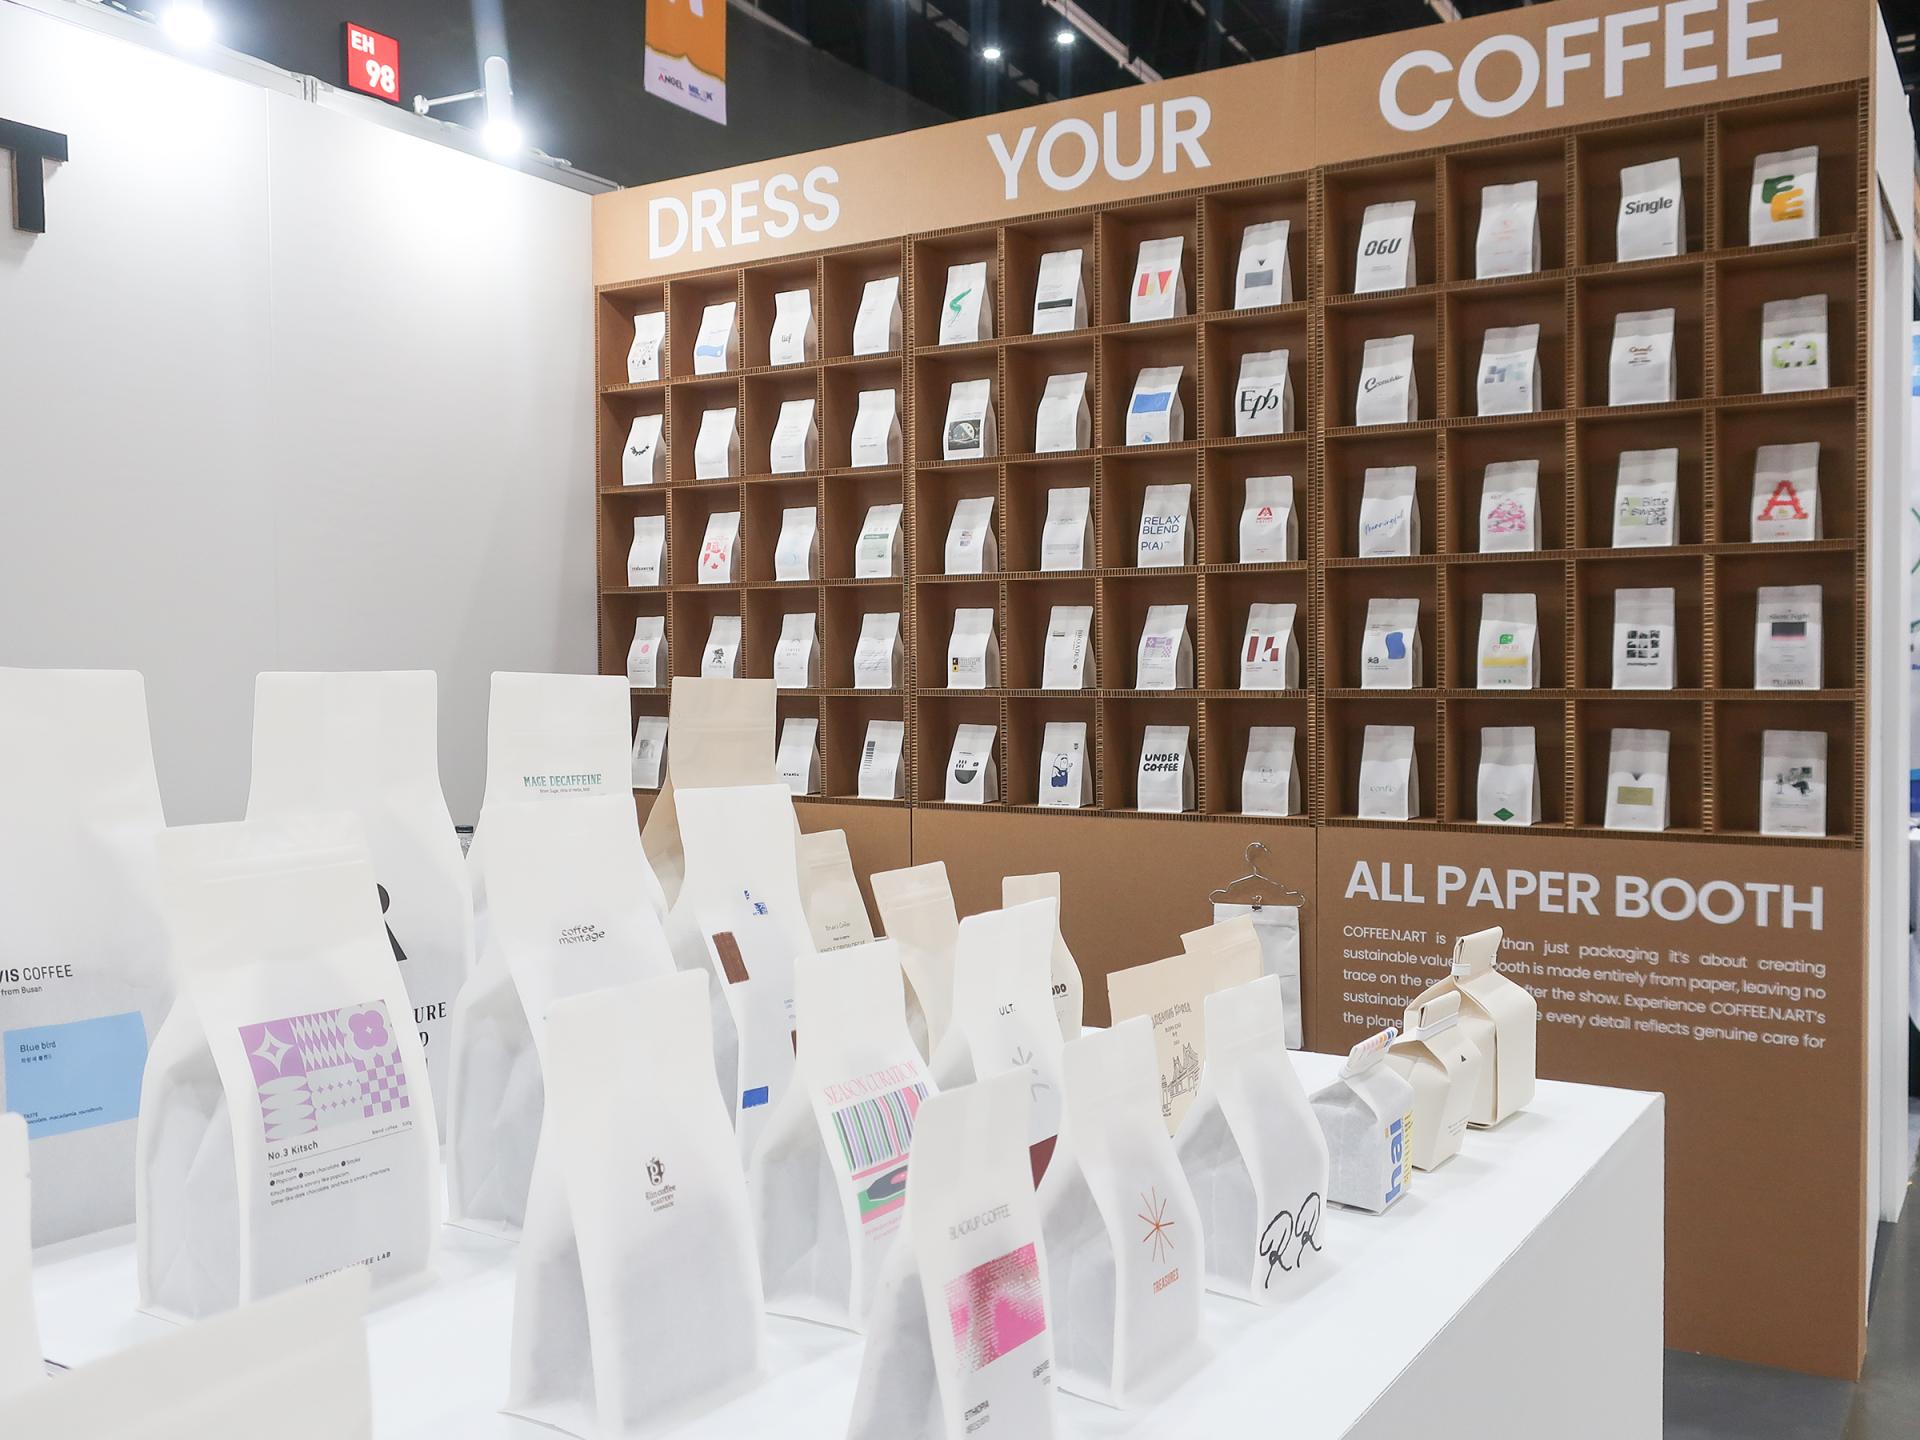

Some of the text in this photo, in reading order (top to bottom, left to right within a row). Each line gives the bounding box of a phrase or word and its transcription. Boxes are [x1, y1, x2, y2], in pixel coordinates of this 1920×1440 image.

[351, 29, 375, 56] EH
[1378, 0, 1783, 132] COFFEE
[366, 59, 396, 93] 98
[658, 73, 683, 90] ANGEL
[986, 96, 1211, 200] YOUR
[648, 165, 841, 260] DRESS
[1625, 197, 1673, 215] Single
[1364, 238, 1402, 256] OGU
[1144, 515, 1180, 525] RELAX
[1143, 525, 1179, 534] BLEND
[1145, 753, 1179, 762] UNDER
[549, 773, 602, 786] DECAFFEINE
[1344, 861, 1824, 931] ALL PAPER BOOTH
[559, 931, 605, 944] montage
[562, 924, 595, 937] coffee
[1343, 926, 1826, 978] COFFEE.N.ART is than just packaging it's about creating
[23, 964, 73, 981] COFFEE
[1343, 948, 1418, 964] sustainable
[1533, 963, 1544, 975] is
[1546, 966, 1592, 980] made
[1593, 968, 1647, 987] entirely
[1649, 972, 1687, 988] from
[1689, 977, 1740, 995] paper,
[1742, 980, 1801, 1001] leaving
[1804, 987, 1826, 999] no
[22, 985, 43, 995] Busan
[1343, 969, 1377, 982] trace
[1380, 973, 1396, 984] on
[1400, 973, 1422, 987] the
[1552, 987, 1576, 1001] the
[1579, 990, 1621, 1005] show.
[1624, 994, 1706, 1014] Experience
[1343, 1012, 1365, 1025] the
[1540, 1013, 1585, 1028] every
[1589, 1016, 1631, 1030] detail
[1634, 1019, 1689, 1035] reflects
[1694, 1025, 1758, 1041] genuine
[1761, 1033, 1799, 1046] care
[1803, 1033, 1826, 1048] for
[20, 1041, 57, 1053] Blue bird
[291, 1141, 319, 1155] Kitsch
[981, 1203, 1011, 1227] COFFEE
[377, 1251, 391, 1261] LAB
